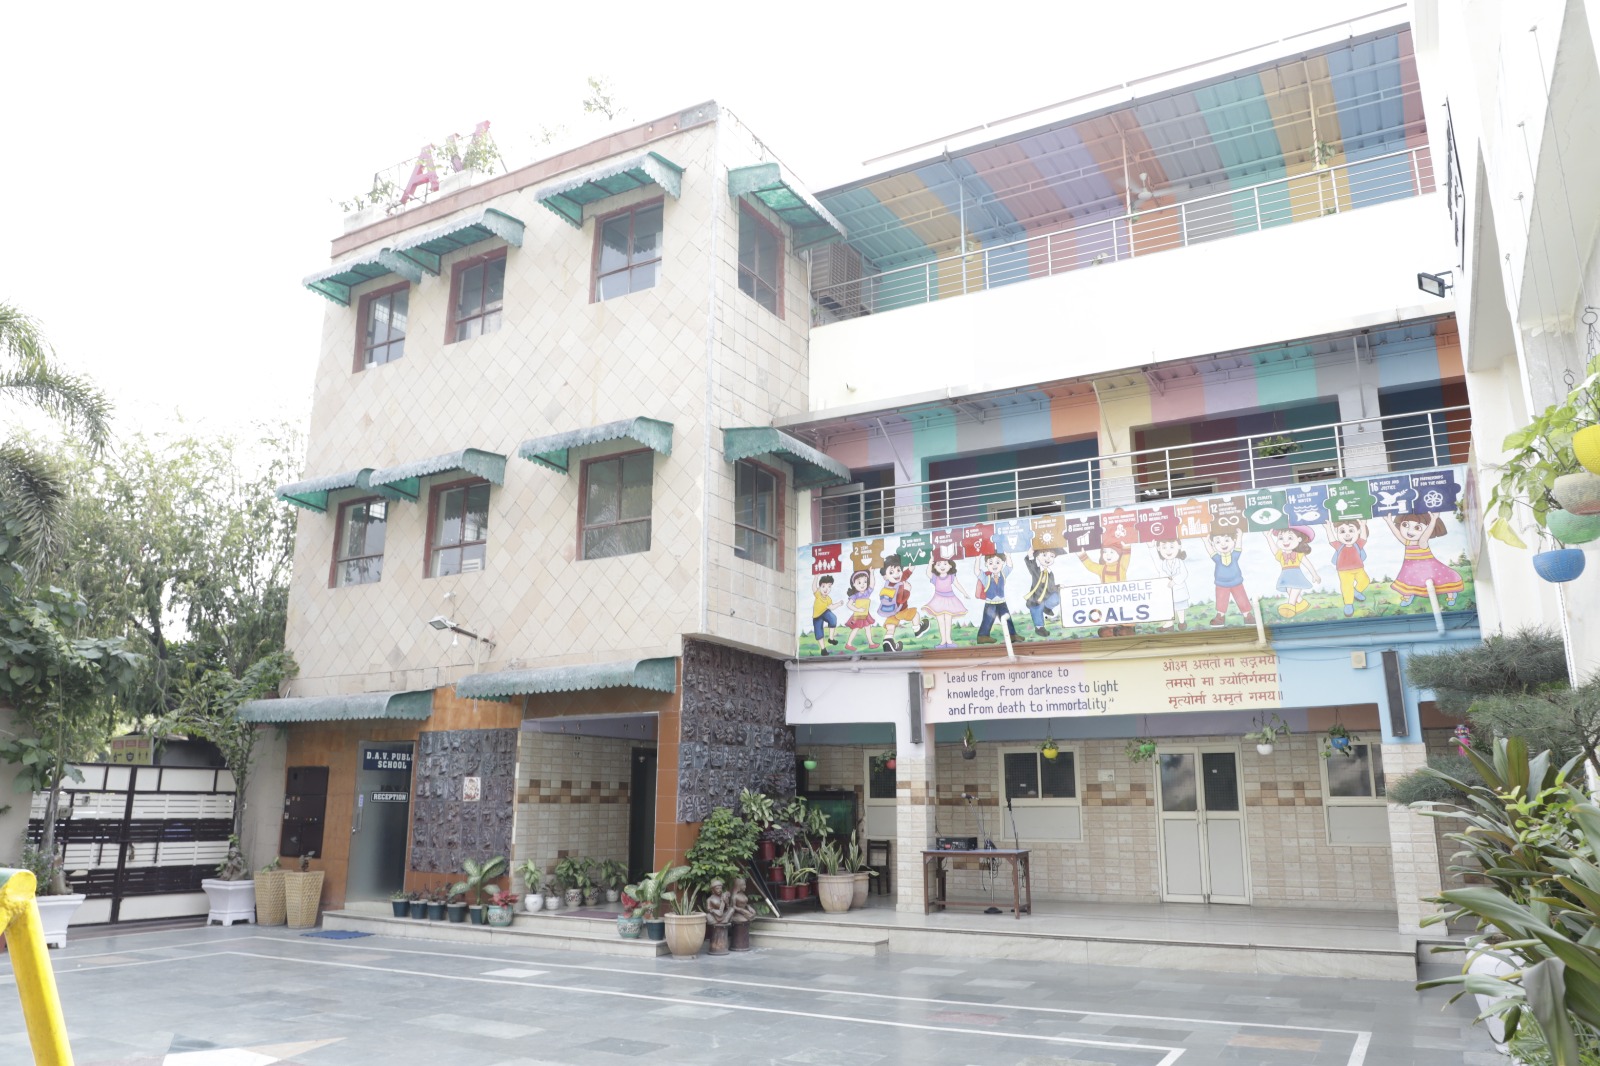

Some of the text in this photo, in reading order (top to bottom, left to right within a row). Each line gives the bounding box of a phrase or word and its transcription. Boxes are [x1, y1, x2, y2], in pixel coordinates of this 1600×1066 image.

[1369, 481, 1379, 492] 16
[1412, 477, 1419, 487] 17
[1329, 487, 1337, 497] 15
[1248, 496, 1257, 507] 13
[1288, 494, 1296, 505] 14
[1210, 503, 1218, 514] 12
[1102, 516, 1108, 525] 9
[1139, 513, 1148, 523] 10
[965, 529, 970, 538] 5
[1068, 525, 1073, 533] 8
[901, 539, 907, 548] 3
[934, 535, 939, 544] 4
[854, 546, 859, 556] 2
[1071, 581, 1152, 597] SUSTAINABLE
[1072, 592, 1152, 607] DEVELOPMENT
[1072, 604, 1150, 624] GOALS
[1223, 658, 1235, 667] मा
[967, 674, 978, 682] us
[1008, 669, 1053, 683] ignorance
[1057, 666, 1069, 678] to
[1201, 677, 1214, 686] मा
[1027, 683, 1076, 696] darkness
[1078, 681, 1090, 693] to
[1093, 679, 1119, 696] light
[948, 703, 966, 716] and
[997, 700, 1026, 713] death
[1030, 700, 1043, 712] to
[366, 751, 389, 760] D.A.V.
[377, 760, 407, 769] SCHOOL
[373, 793, 407, 801] RECEPTION
